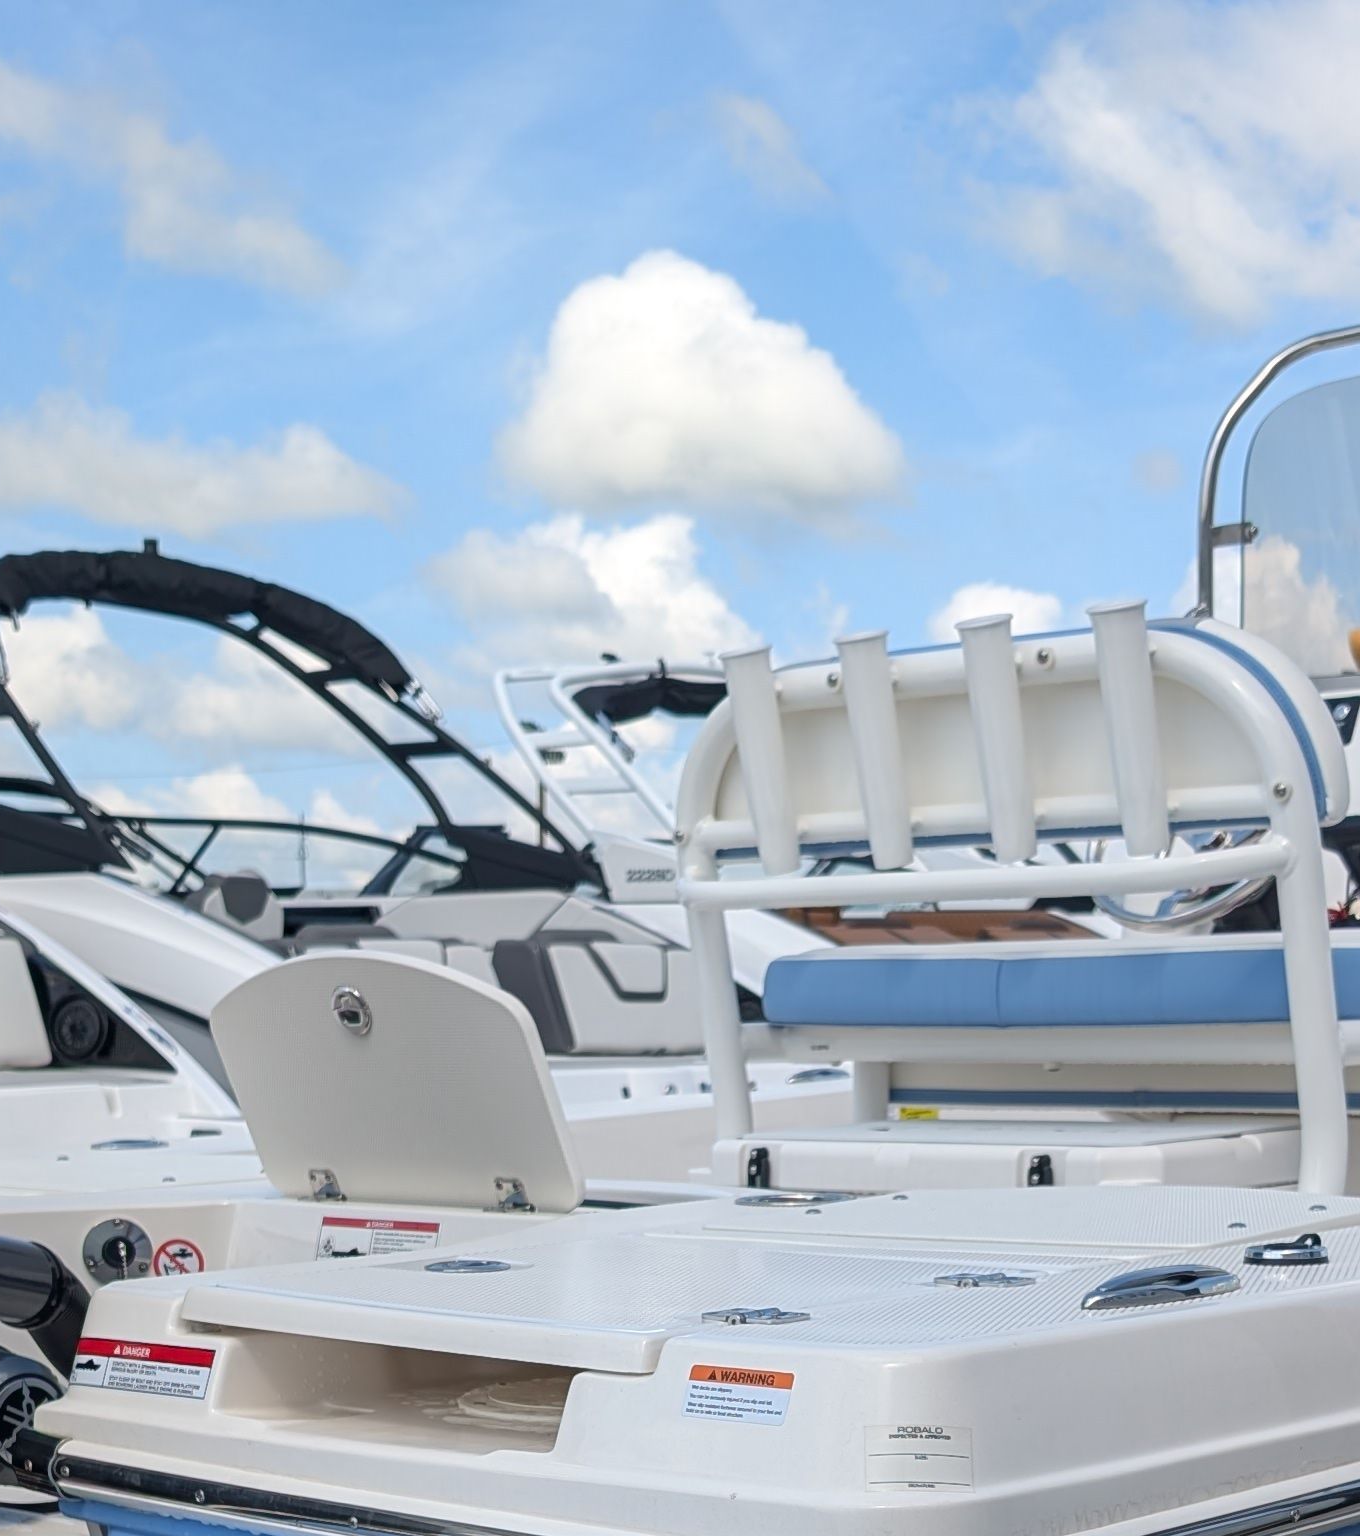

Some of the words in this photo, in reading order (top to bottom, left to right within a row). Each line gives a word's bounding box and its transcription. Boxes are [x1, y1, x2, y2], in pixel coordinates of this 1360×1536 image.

[122, 1346, 151, 1358] DANGER
[720, 1370, 776, 1386] WARNING
[897, 1426, 944, 1435] ROBALO
